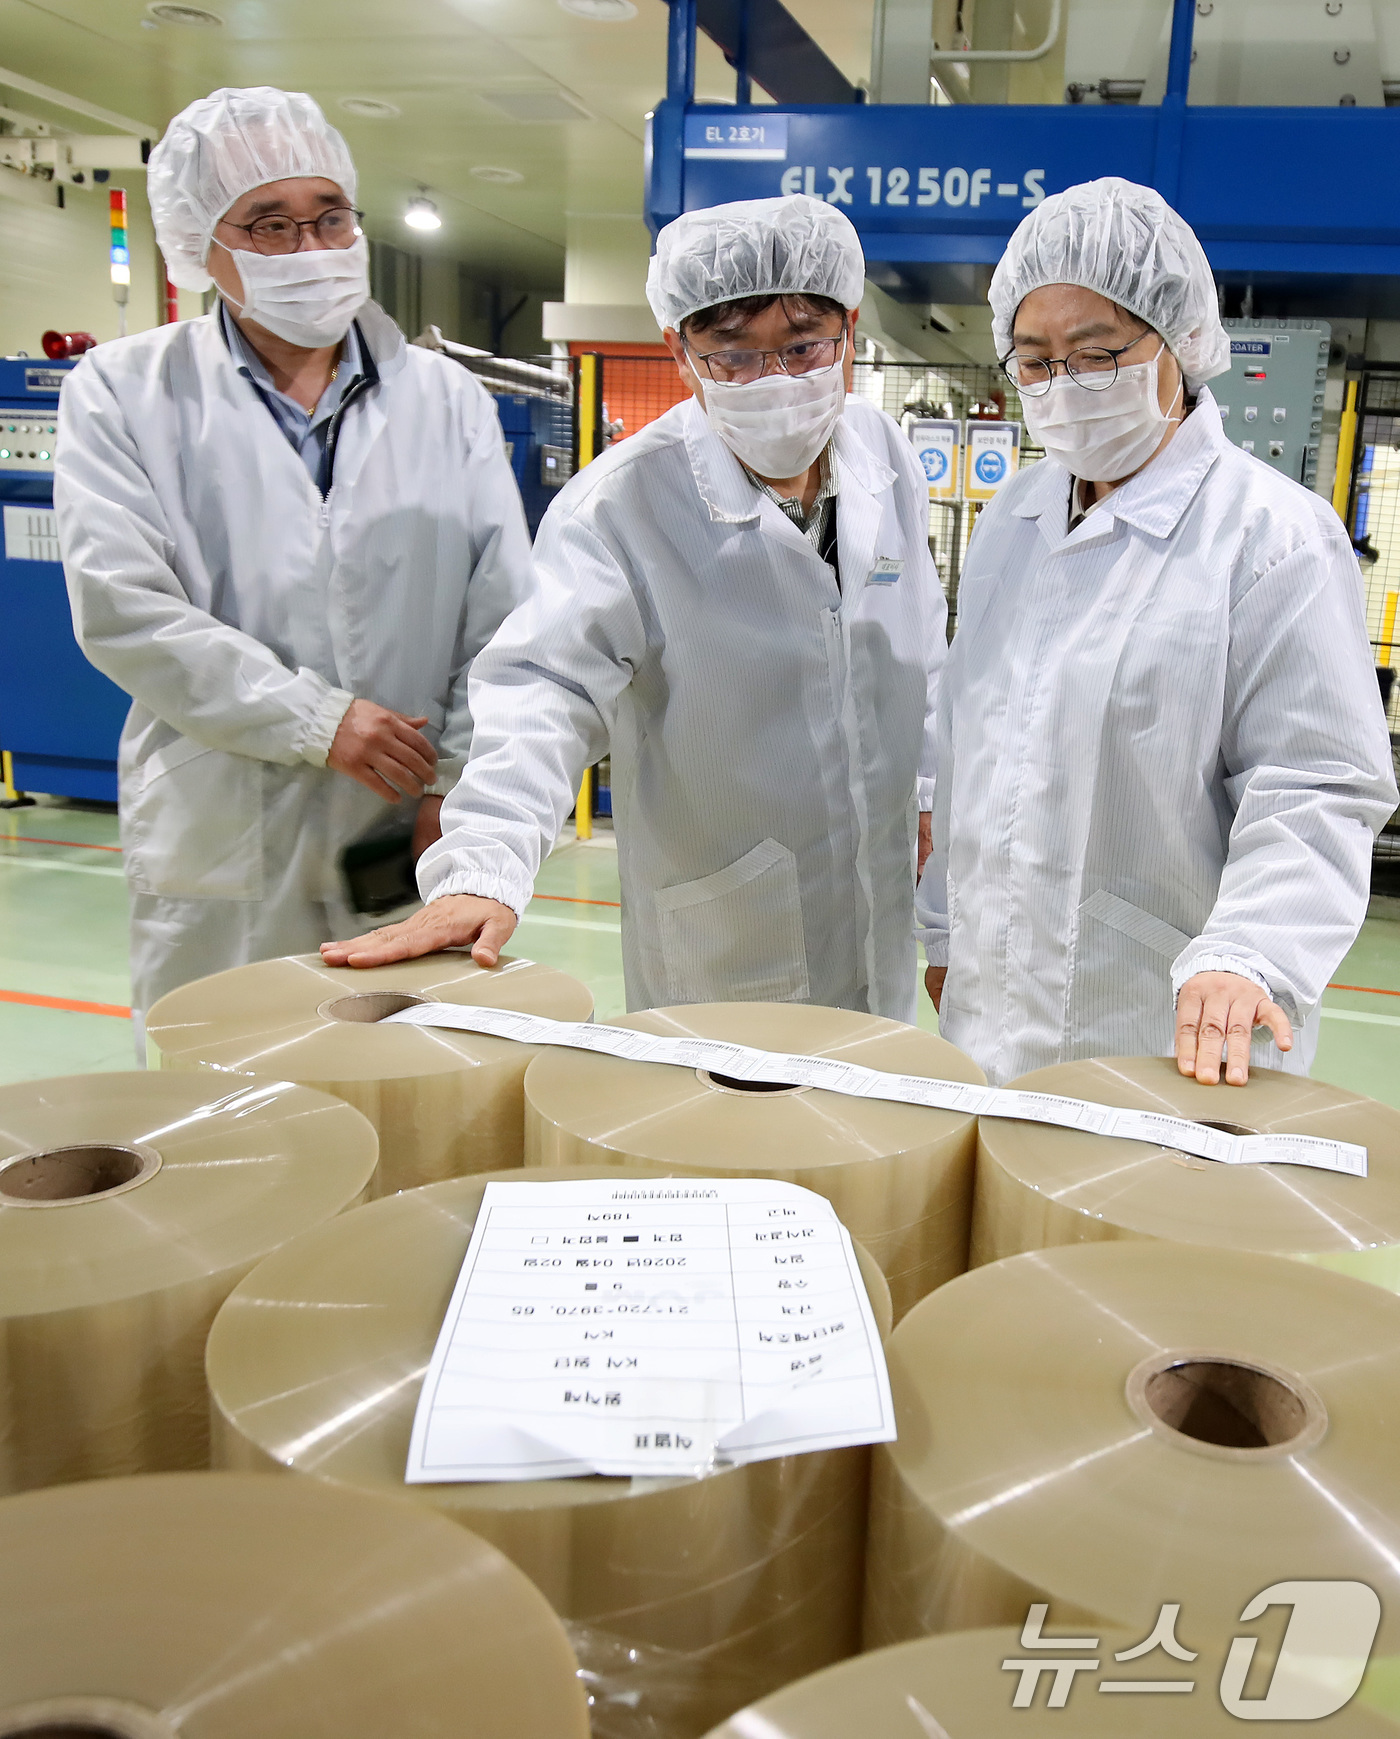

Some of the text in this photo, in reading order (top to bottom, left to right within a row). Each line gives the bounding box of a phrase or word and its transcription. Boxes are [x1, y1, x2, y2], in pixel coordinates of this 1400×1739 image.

[706, 126, 765, 143] EL 2호기
[781, 166, 1046, 208] ELX 1250F-S
[653, 1233, 683, 1243] 합격
[755, 1228, 814, 1242] 검사결과
[523, 1257, 687, 1268] 2026년 04월 02일
[777, 1279, 808, 1289] 수량
[511, 1306, 535, 1316] 65
